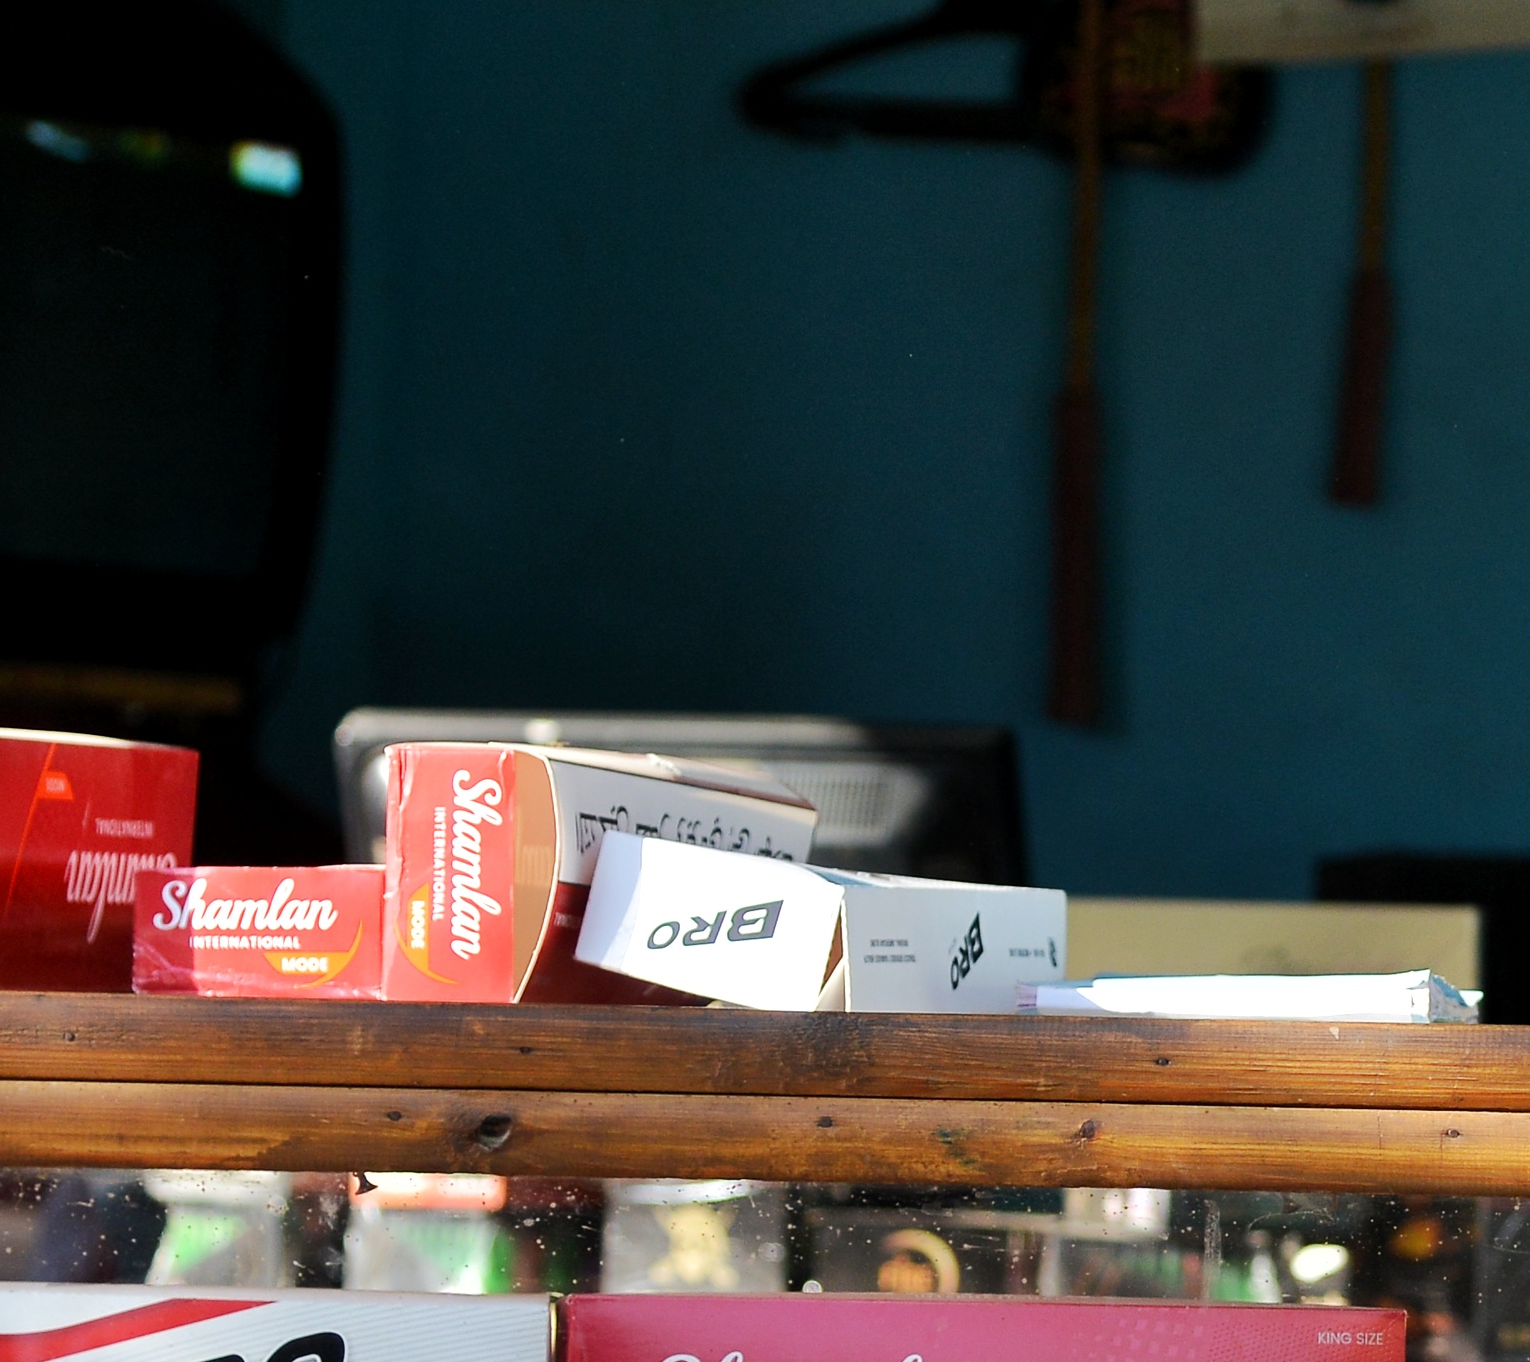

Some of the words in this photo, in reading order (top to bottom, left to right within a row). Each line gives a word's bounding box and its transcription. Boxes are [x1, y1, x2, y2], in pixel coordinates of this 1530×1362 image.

[433, 806, 446, 922] INTERNATIONAL
[450, 769, 503, 960] Shamlan
[153, 878, 338, 932] Shamlan
[410, 899, 425, 950] MODE
[646, 899, 785, 950] BRO
[189, 935, 301, 951] INTERNATIONAL
[281, 956, 329, 973] MODE
[949, 912, 985, 991] BRO
[1316, 1330, 1352, 1346] KING
[1355, 1331, 1385, 1347] SIZE
